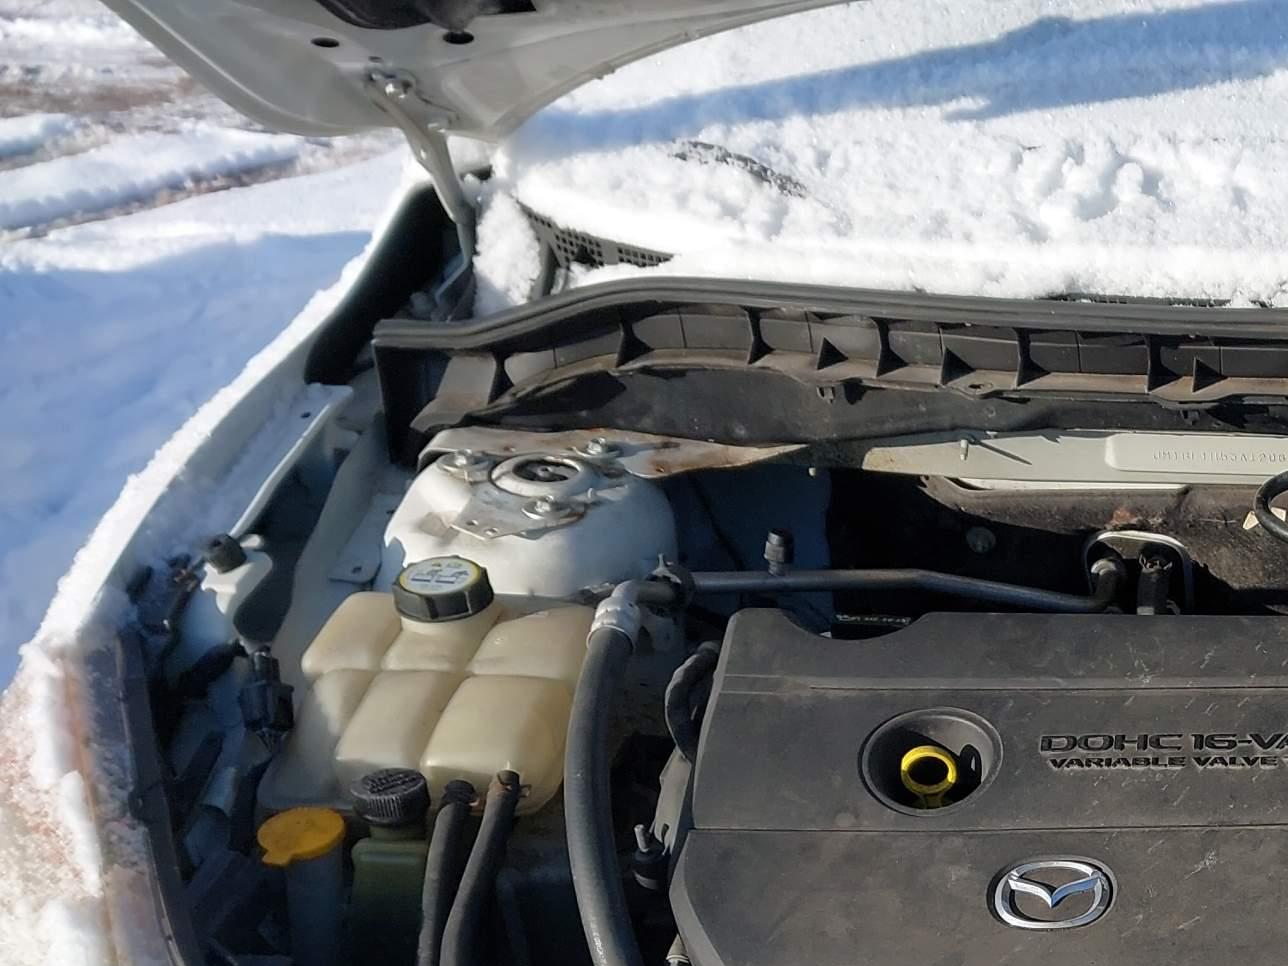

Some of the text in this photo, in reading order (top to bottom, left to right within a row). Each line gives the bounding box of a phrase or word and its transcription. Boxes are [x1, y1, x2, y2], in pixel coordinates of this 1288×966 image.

[1040, 733, 1184, 752] DOHC
[1049, 756, 1187, 769] VARIABLE
[1193, 755, 1279, 768] VALVE
